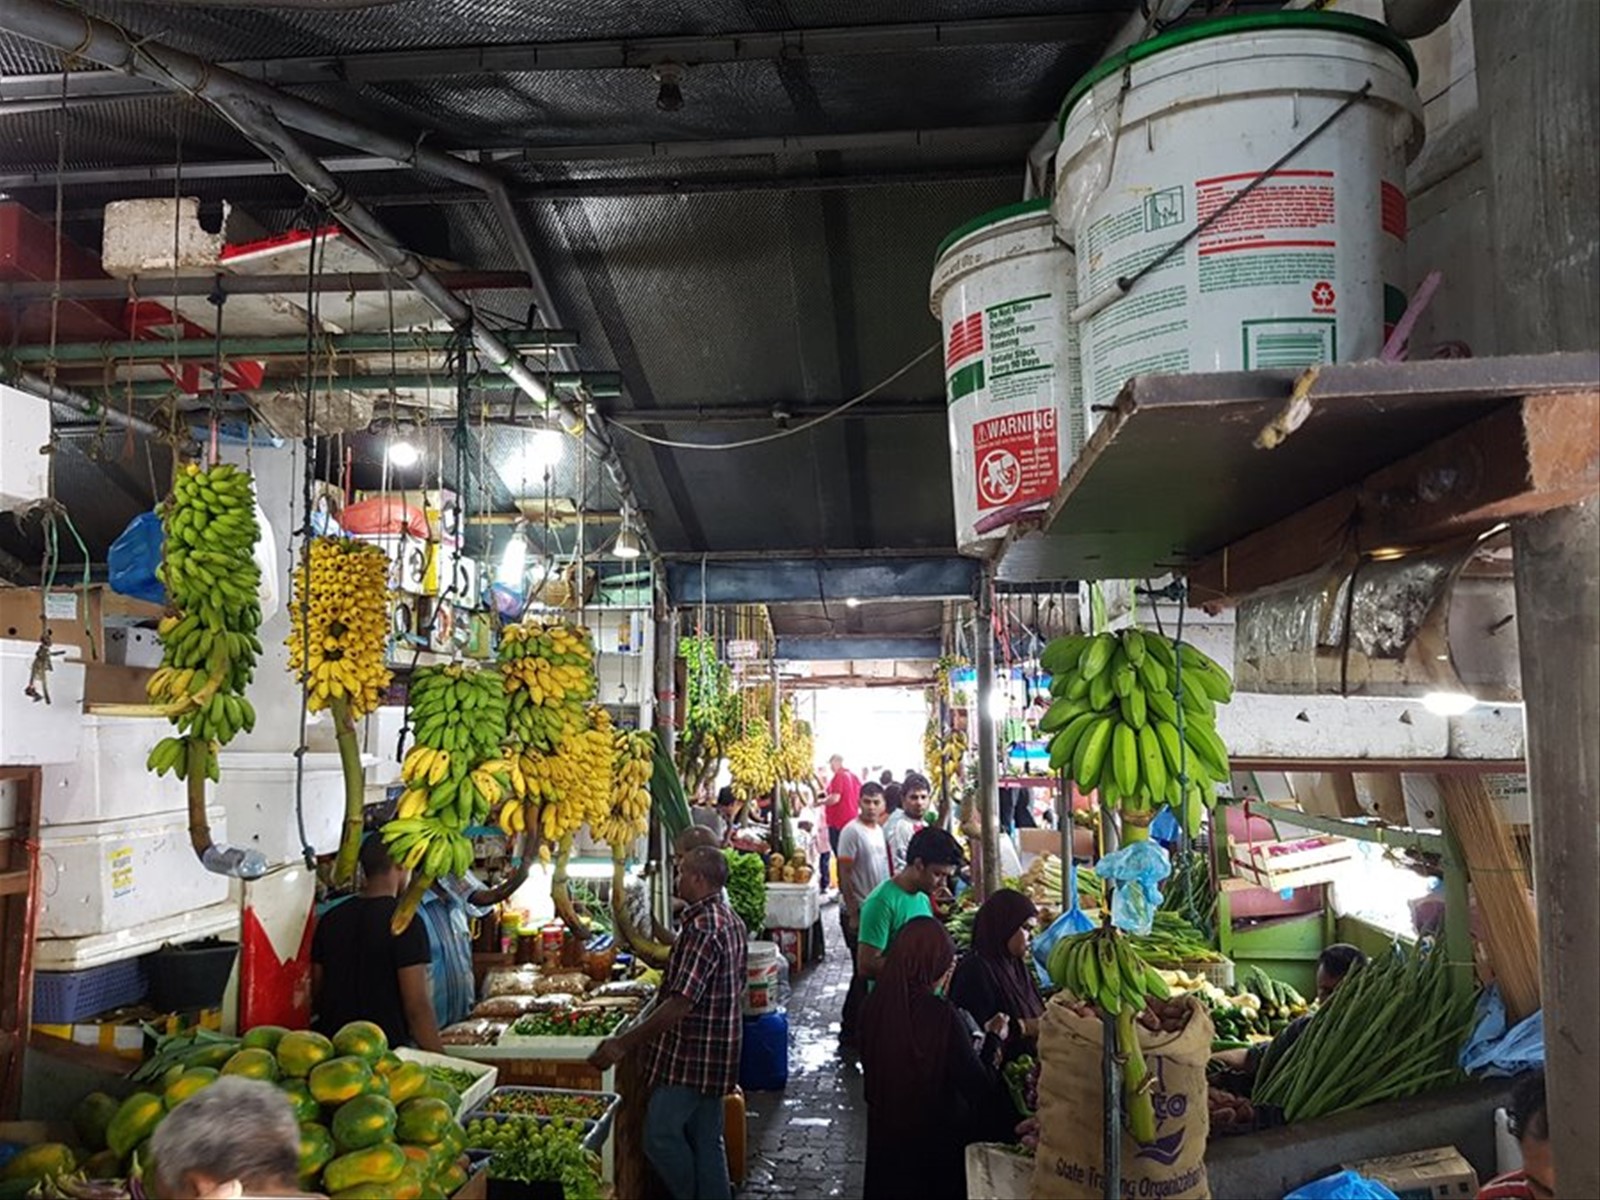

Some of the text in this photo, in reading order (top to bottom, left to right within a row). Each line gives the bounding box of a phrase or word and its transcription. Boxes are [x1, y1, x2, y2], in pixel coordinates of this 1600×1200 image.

[1016, 325, 1036, 334] From
[1014, 347, 1036, 358] Stock
[1022, 357, 1040, 367] Days
[987, 410, 1054, 439] WARNING
[1055, 1157, 1084, 1184] State
[1139, 1161, 1205, 1198] Organization
